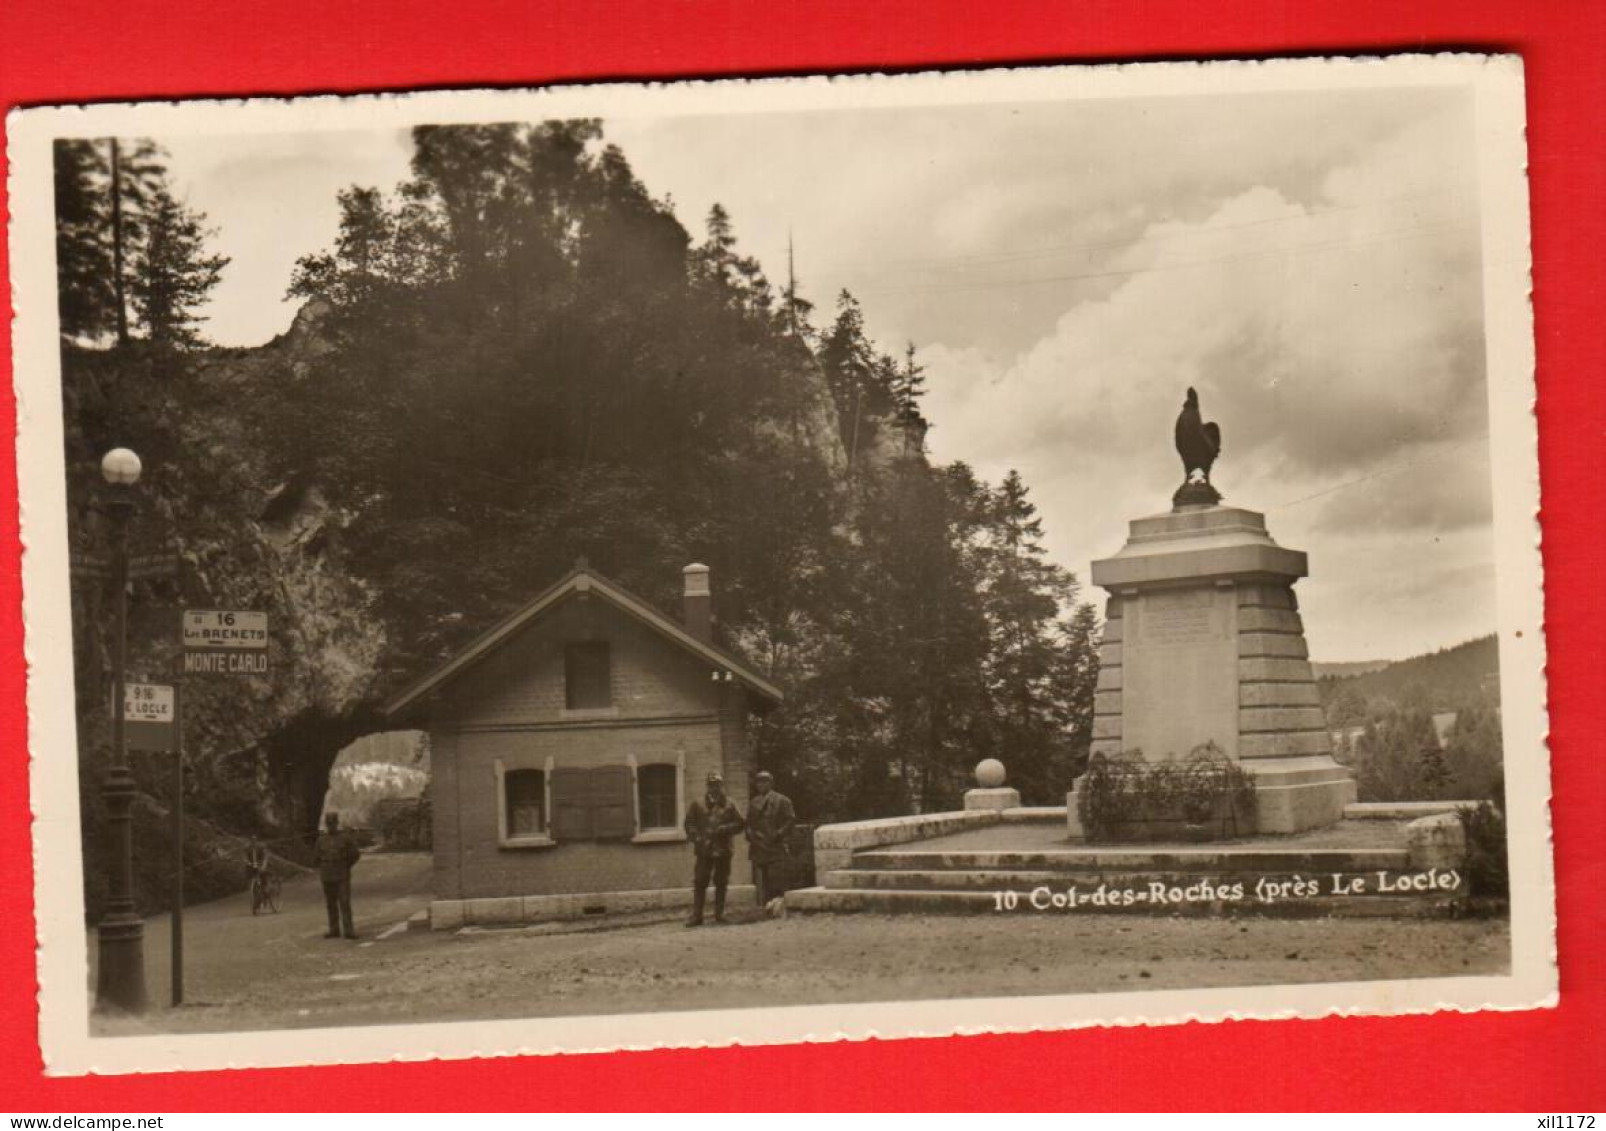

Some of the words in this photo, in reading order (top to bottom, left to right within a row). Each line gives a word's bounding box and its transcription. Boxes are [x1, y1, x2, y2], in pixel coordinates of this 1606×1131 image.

[218, 612, 235, 626] 16
[202, 629, 265, 640] BRENETS
[184, 652, 226, 672] MONTE
[229, 653, 268, 672] CARLO
[135, 702, 168, 714] LOCLE
